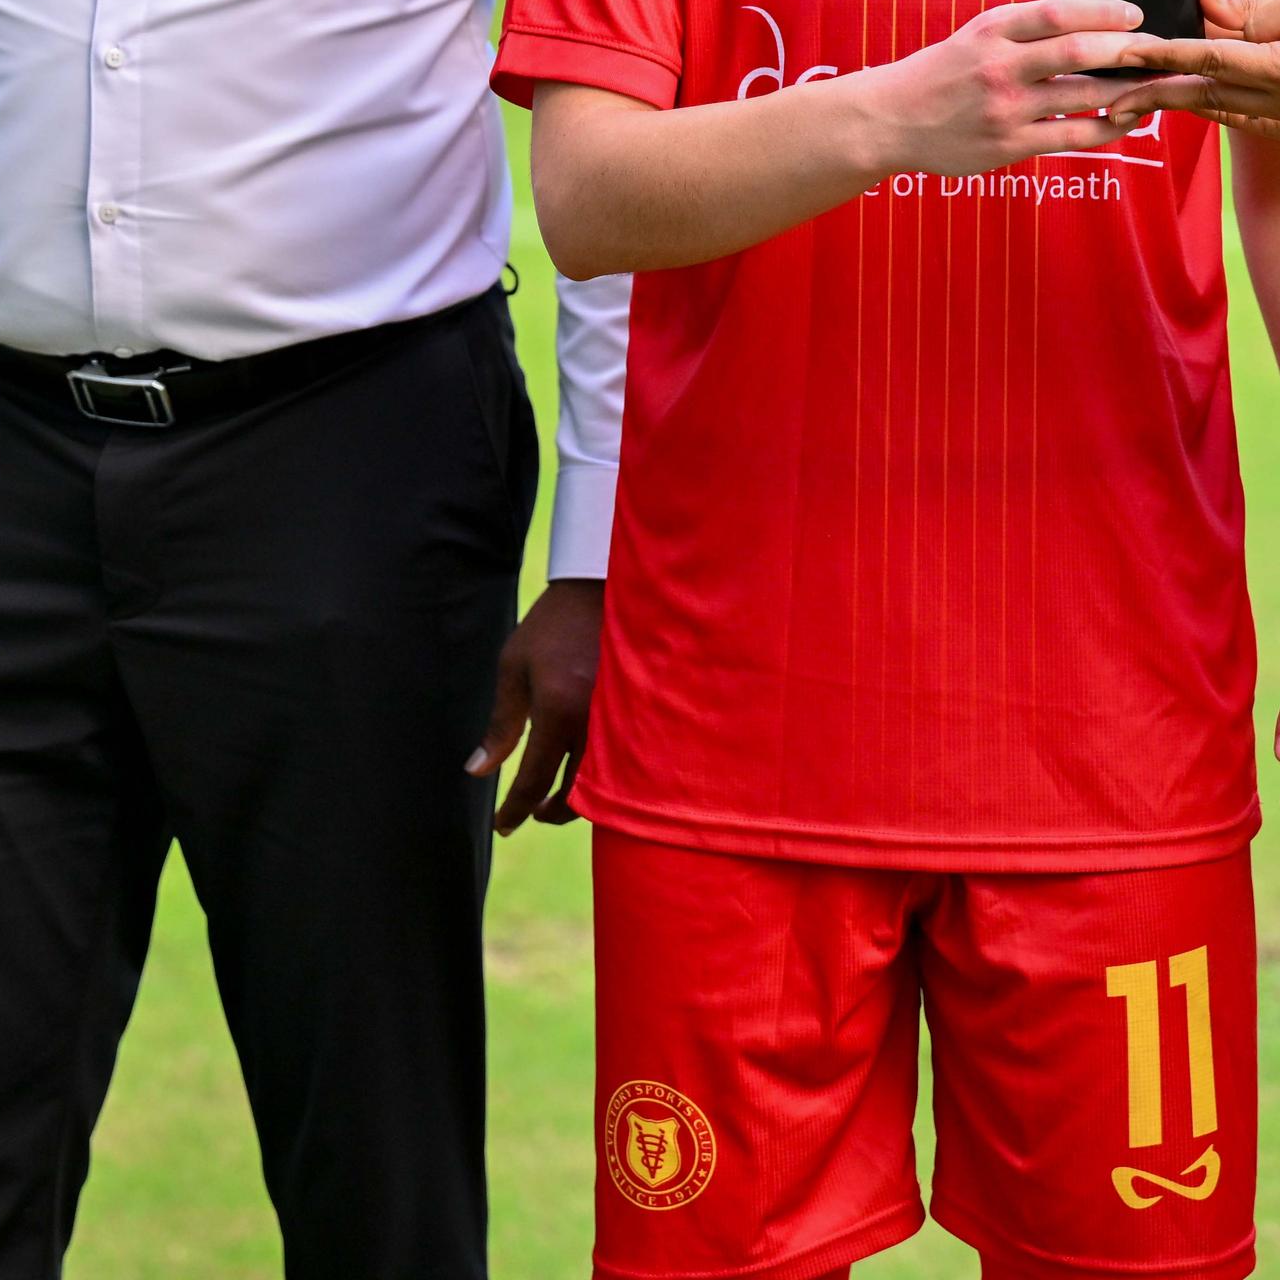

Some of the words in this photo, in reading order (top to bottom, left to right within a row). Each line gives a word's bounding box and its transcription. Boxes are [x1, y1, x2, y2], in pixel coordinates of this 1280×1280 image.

[893, 171, 928, 197] of
[1106, 945, 1218, 1149] 11
[634, 1084, 694, 1117] SPORTS
[693, 1118, 712, 1162] CLUB
[613, 1168, 657, 1206] SINCE
[665, 1178, 702, 1205] 1971
